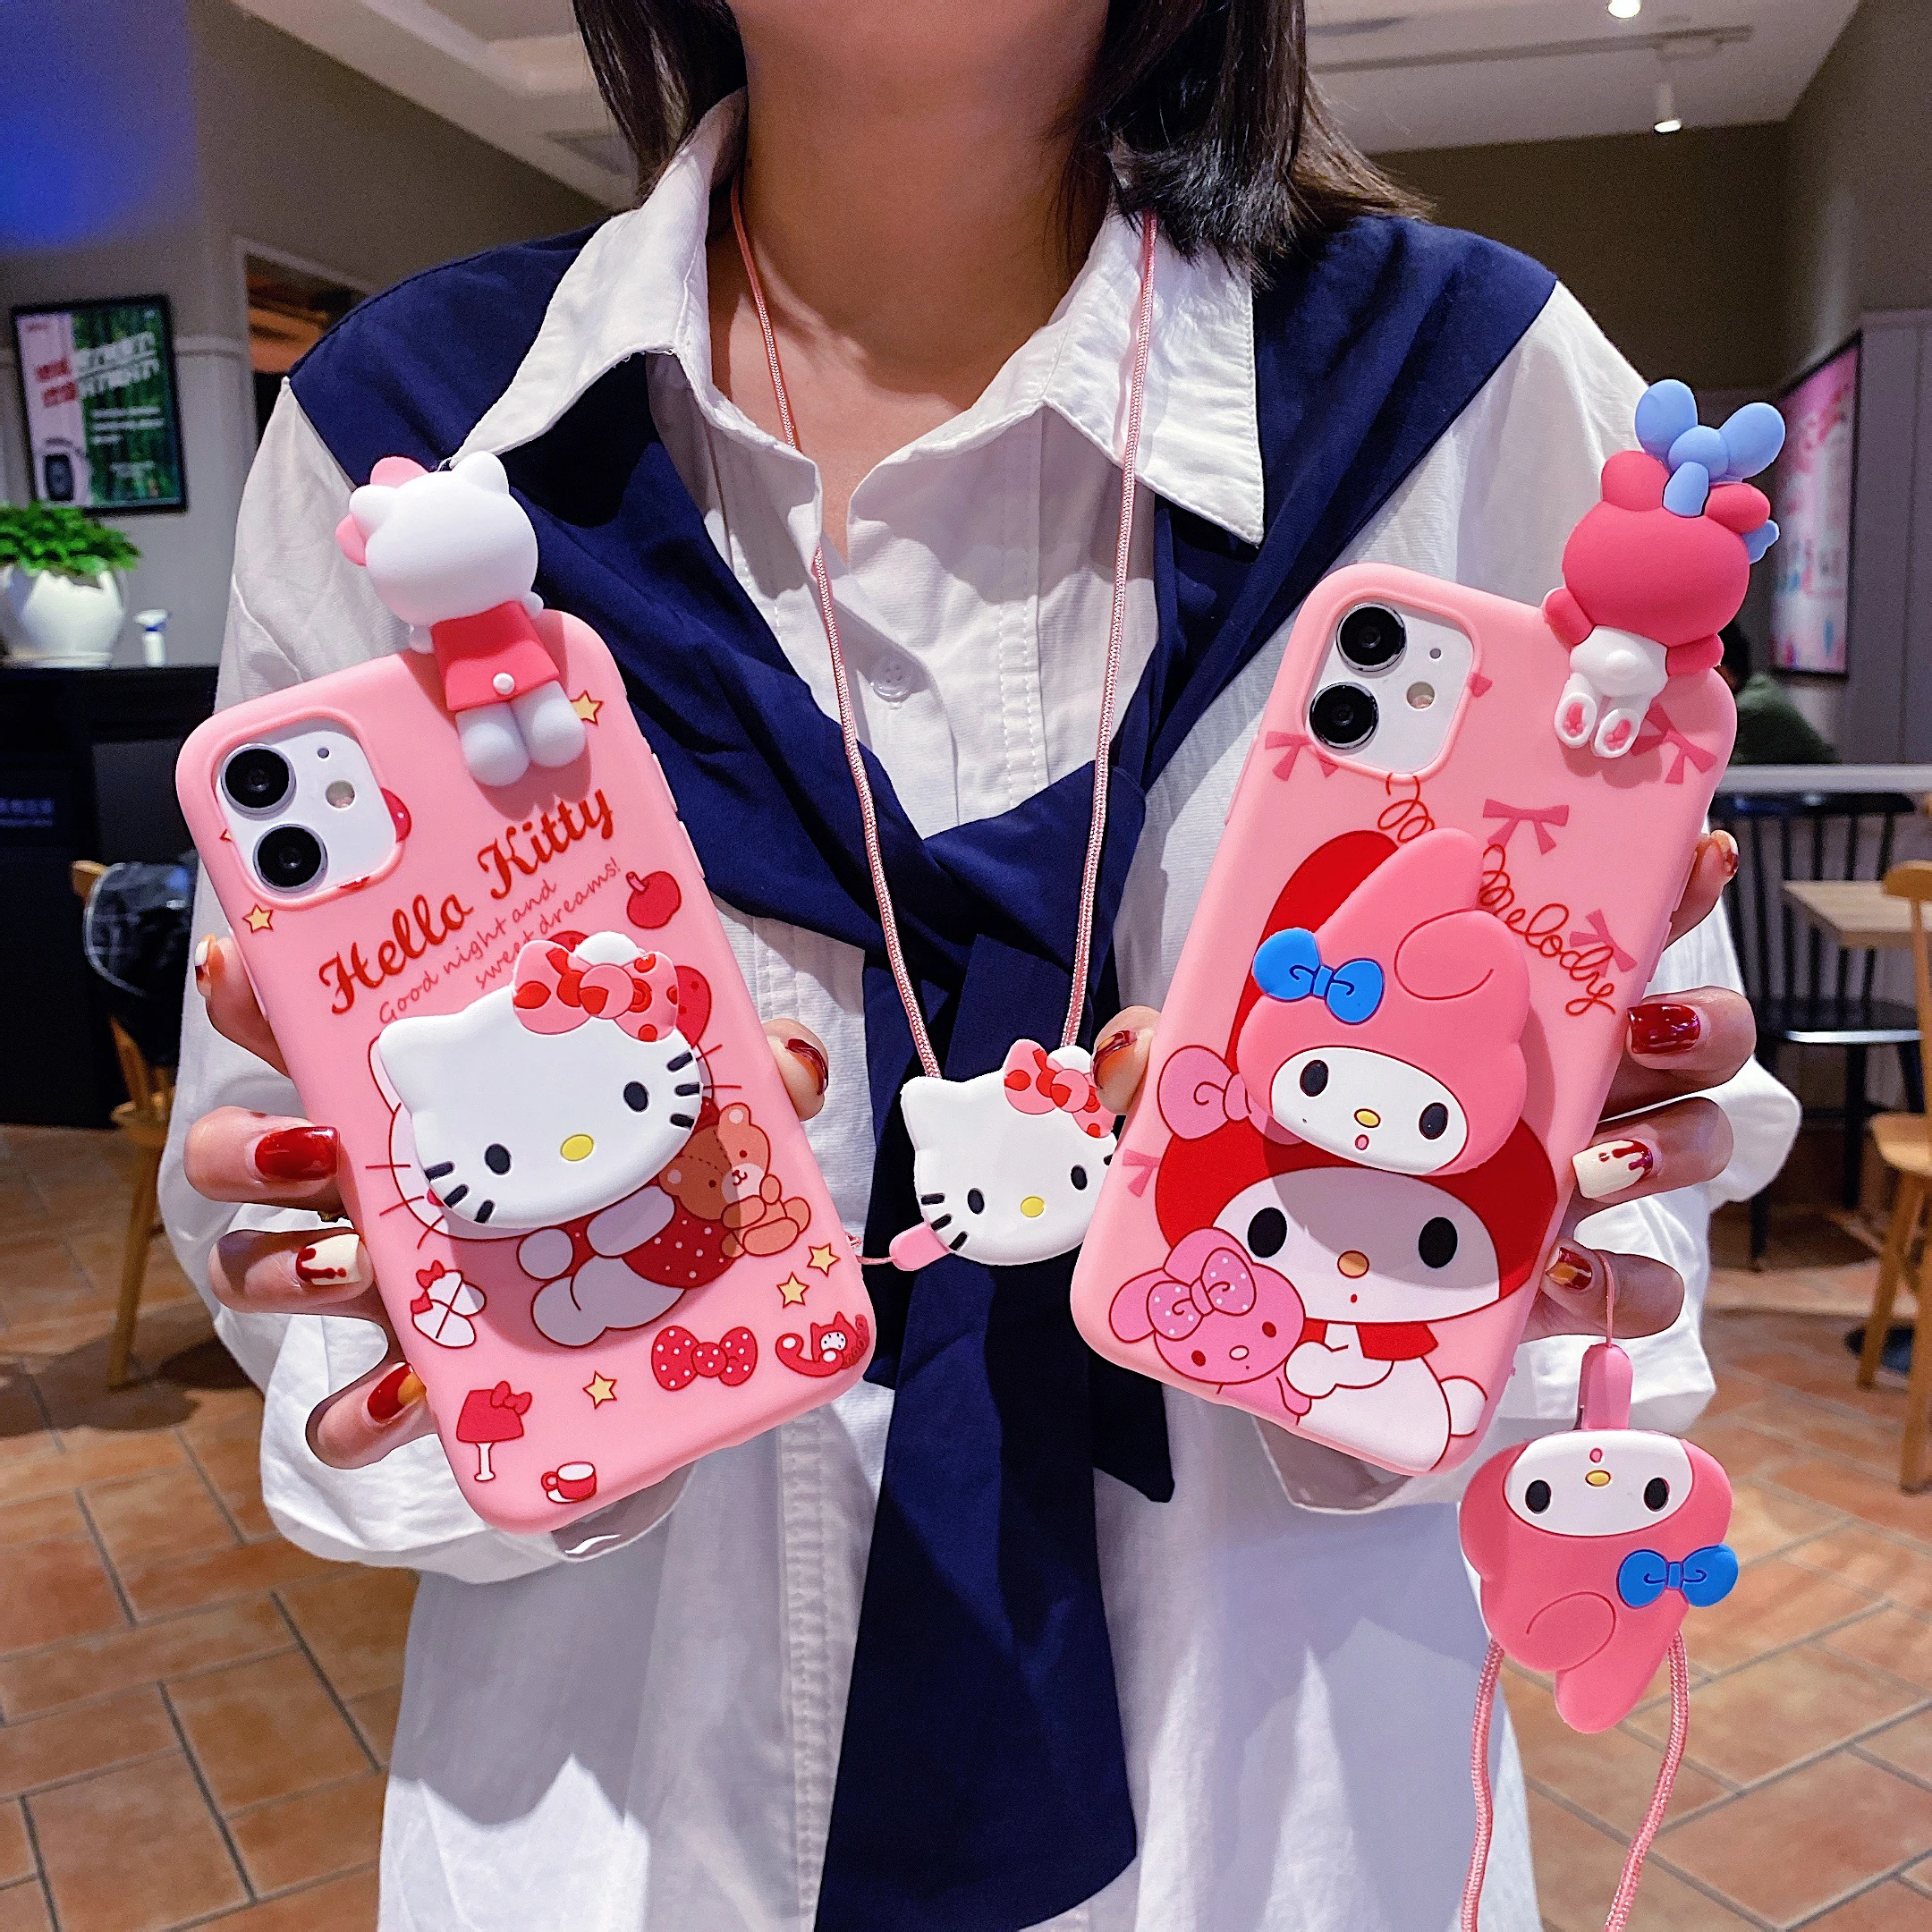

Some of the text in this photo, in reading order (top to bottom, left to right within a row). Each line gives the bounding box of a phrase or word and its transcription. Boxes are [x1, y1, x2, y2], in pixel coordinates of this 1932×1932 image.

[318, 788, 614, 1015] Hello Kitty
[378, 878, 557, 1024] Good night and
[539, 856, 621, 935] dreams!
